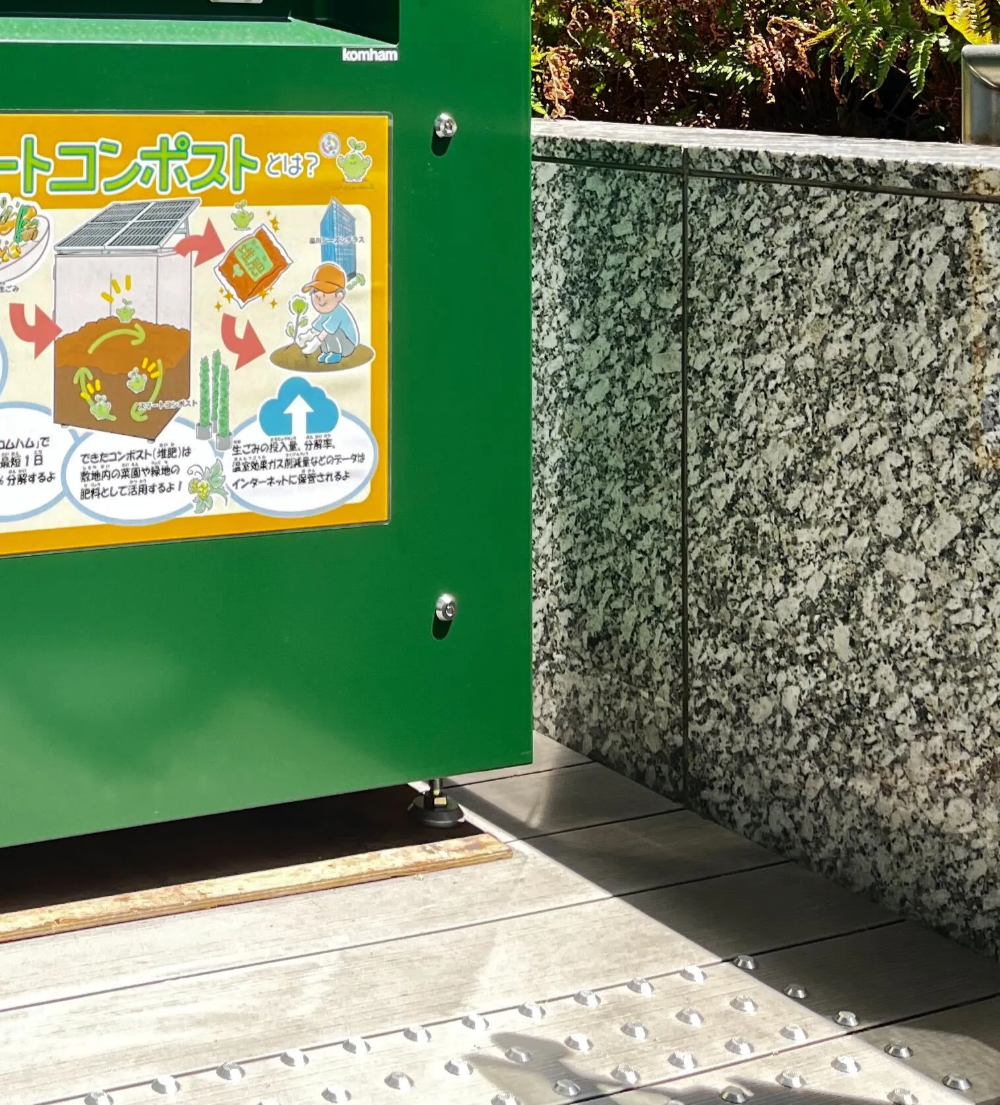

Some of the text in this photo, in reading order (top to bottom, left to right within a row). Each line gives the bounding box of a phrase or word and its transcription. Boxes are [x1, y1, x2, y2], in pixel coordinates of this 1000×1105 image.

[342, 47, 398, 61] komham
[232, 452, 366, 473] 温室効果ガス削減量などのデータは
[80, 464, 180, 483] 敷地内の菜園や緑地の
[232, 471, 350, 490] インターネットに保管されるよ
